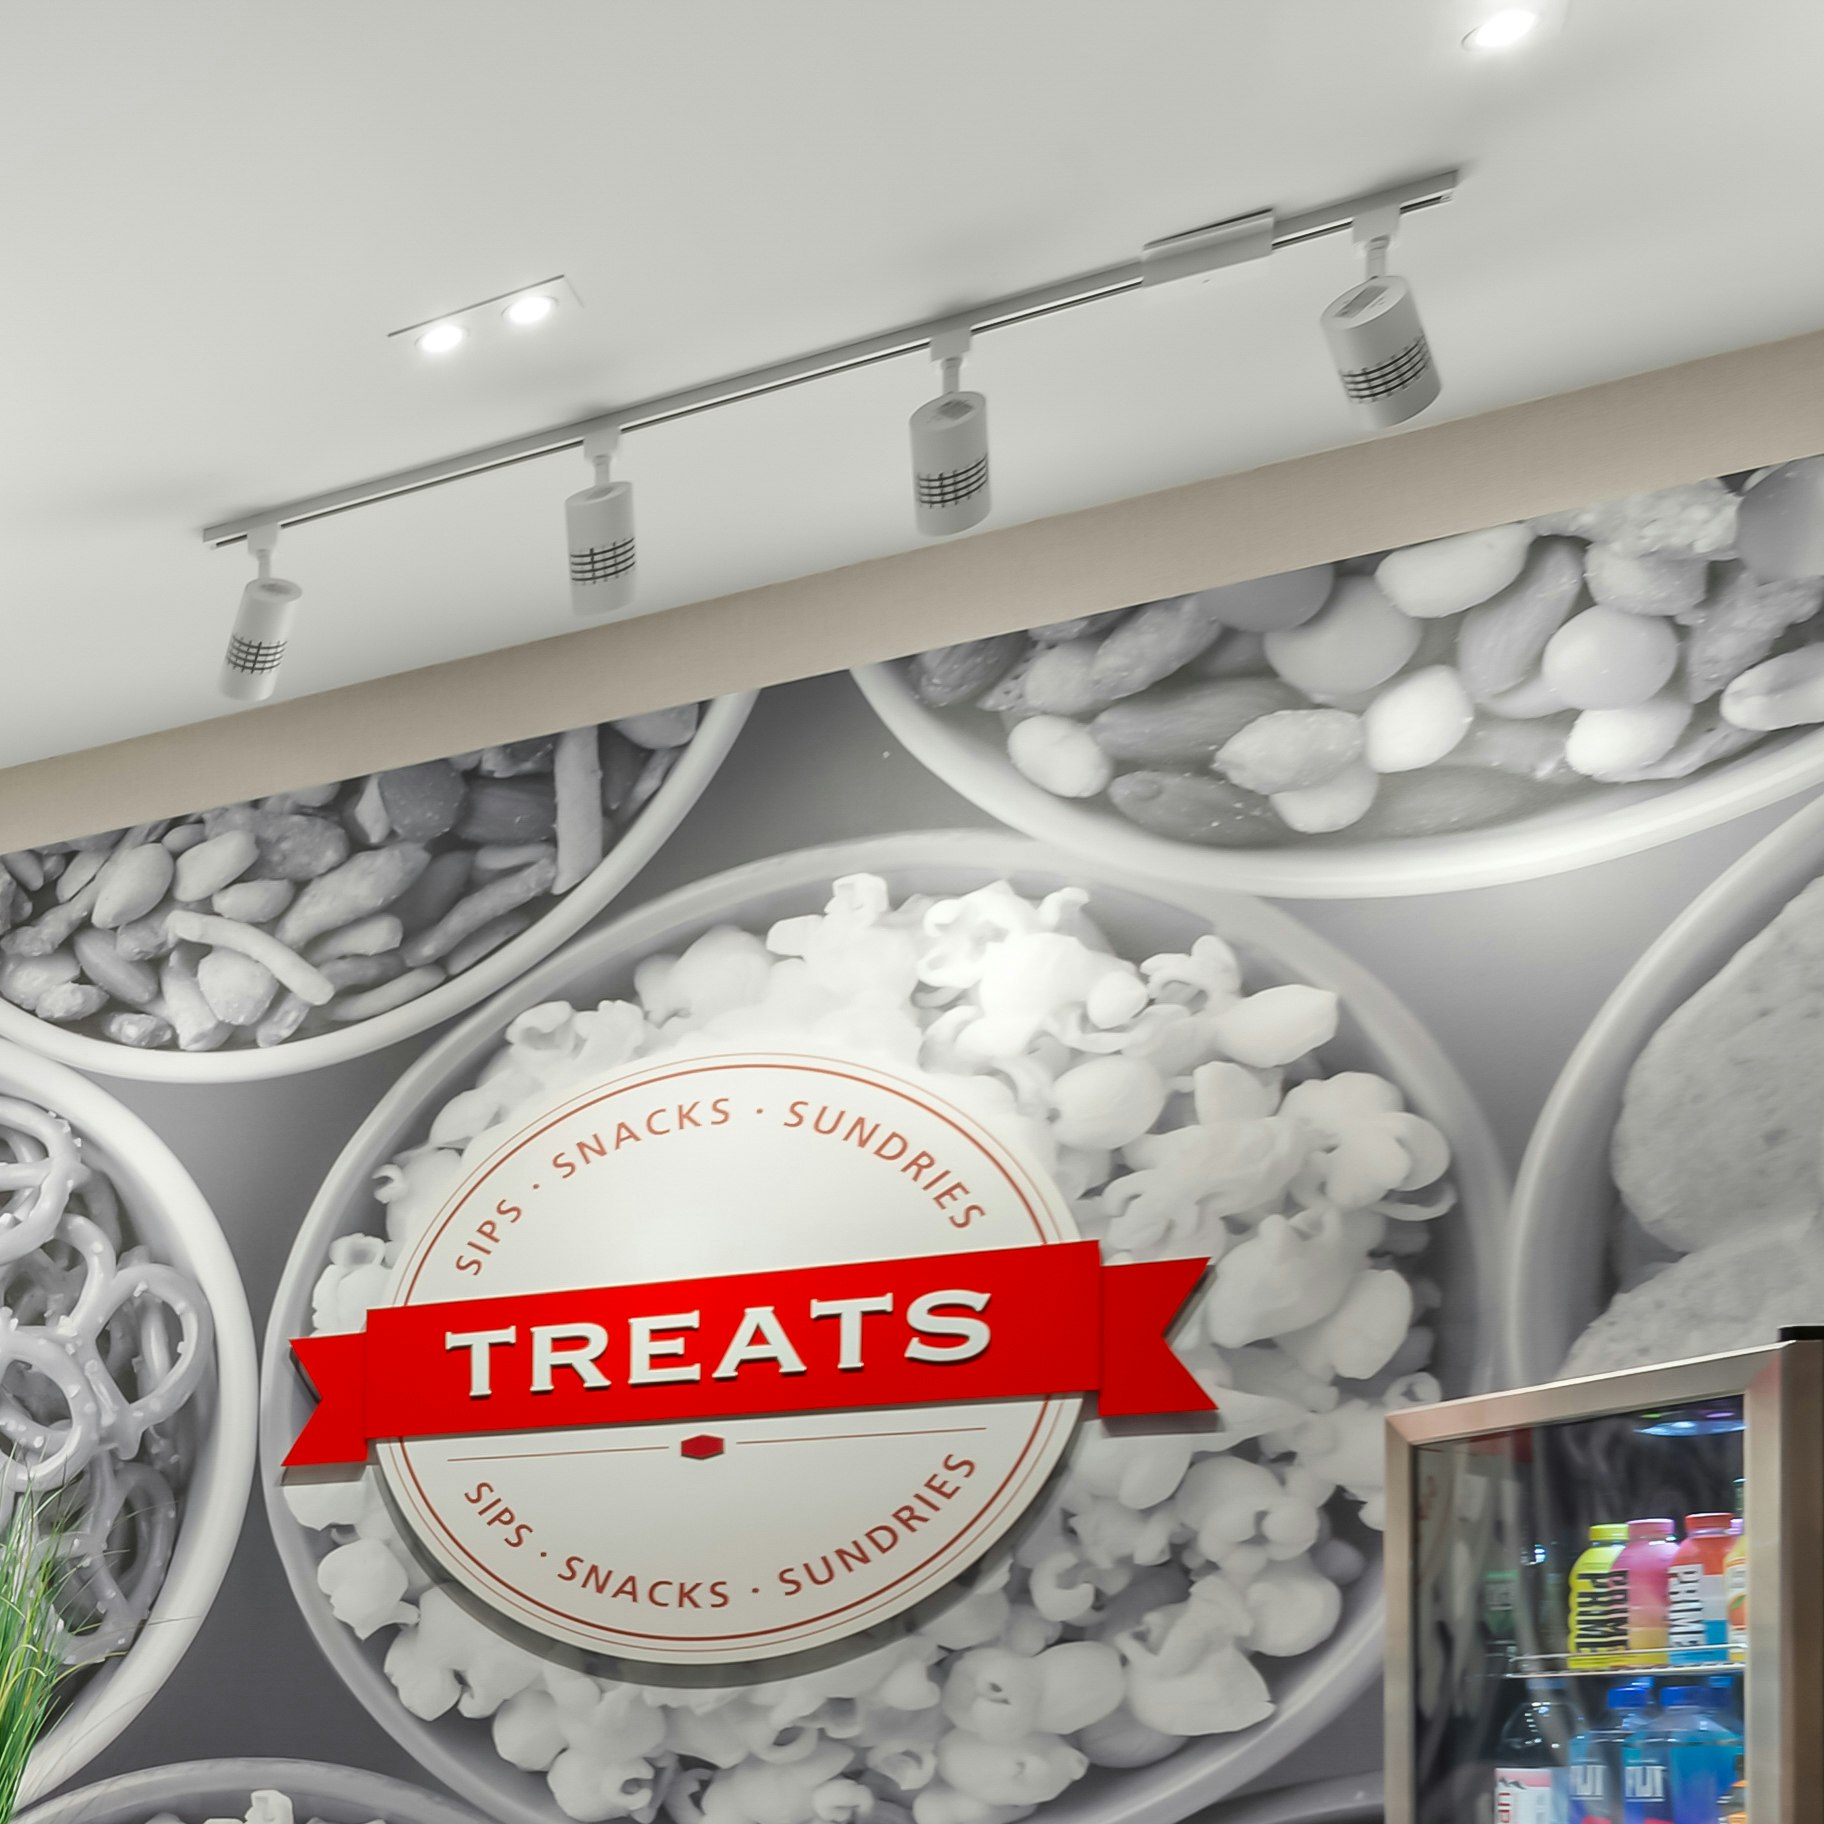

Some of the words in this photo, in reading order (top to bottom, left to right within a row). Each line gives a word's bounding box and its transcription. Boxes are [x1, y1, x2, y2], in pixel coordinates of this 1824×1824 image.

[454, 1197, 523, 1277] SIPS
[551, 1097, 733, 1181] SNACKS
[784, 1099, 987, 1232] SUNDRIES
[444, 1289, 993, 1398] TREATS
[465, 1480, 534, 1550] SIPS
[557, 1554, 731, 1611] SNACKS
[778, 1453, 977, 1598] SUNDRIES
[1670, 1562, 1703, 1648] PRIME
